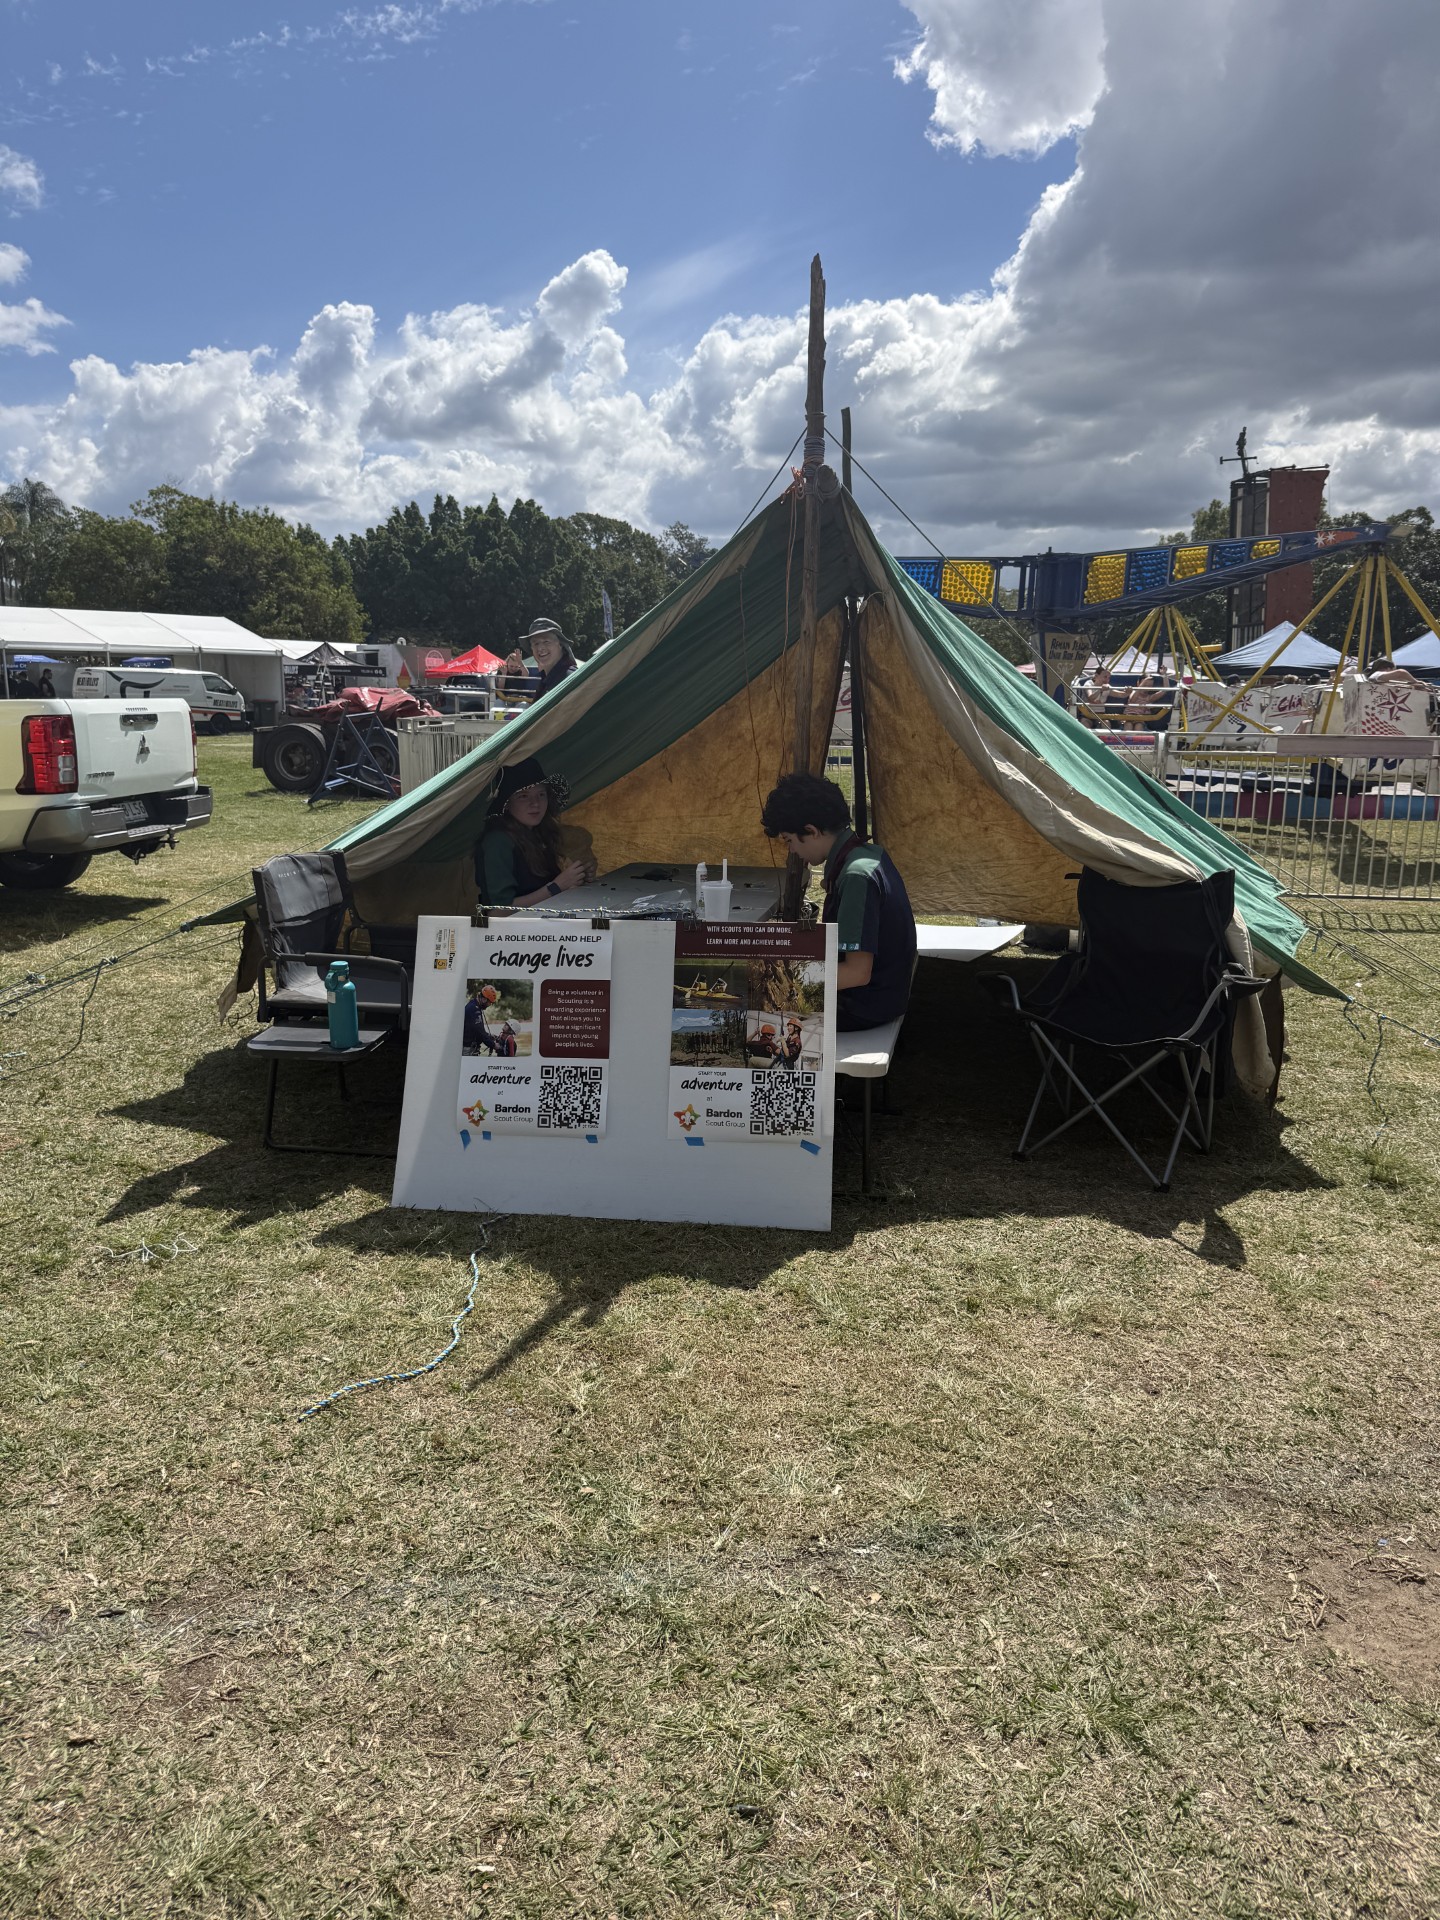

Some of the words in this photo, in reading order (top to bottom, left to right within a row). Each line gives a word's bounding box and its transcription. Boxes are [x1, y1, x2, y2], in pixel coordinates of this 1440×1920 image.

[490, 950, 551, 973] change
[556, 945, 594, 968] lives
[470, 1072, 531, 1085] adventure
[681, 1078, 743, 1091] adventure
[495, 1104, 531, 1113] Bardon
[706, 1108, 743, 1118] Bardon
